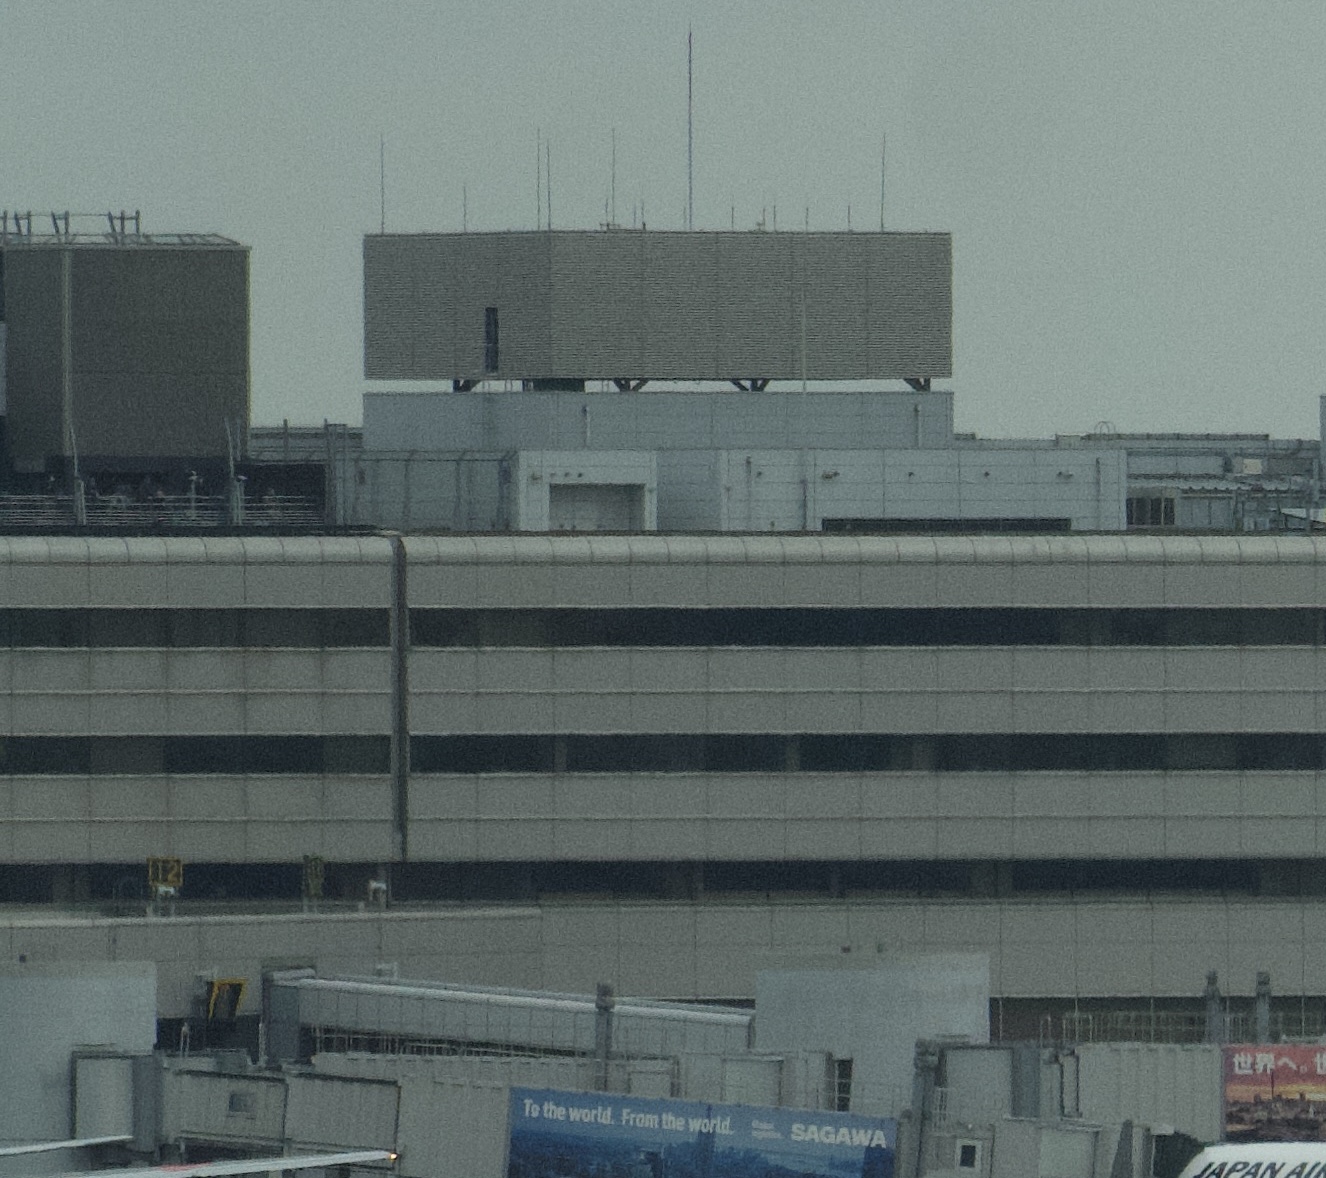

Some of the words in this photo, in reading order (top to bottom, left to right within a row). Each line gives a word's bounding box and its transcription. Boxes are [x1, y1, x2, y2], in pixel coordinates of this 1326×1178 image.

[523, 1099, 539, 1118] To
[542, 1101, 565, 1121] the
[568, 1104, 614, 1125] world.
[621, 1108, 658, 1128] From
[661, 1110, 685, 1131] the
[688, 1114, 735, 1135] world.
[791, 1122, 887, 1149] SAGAWA
